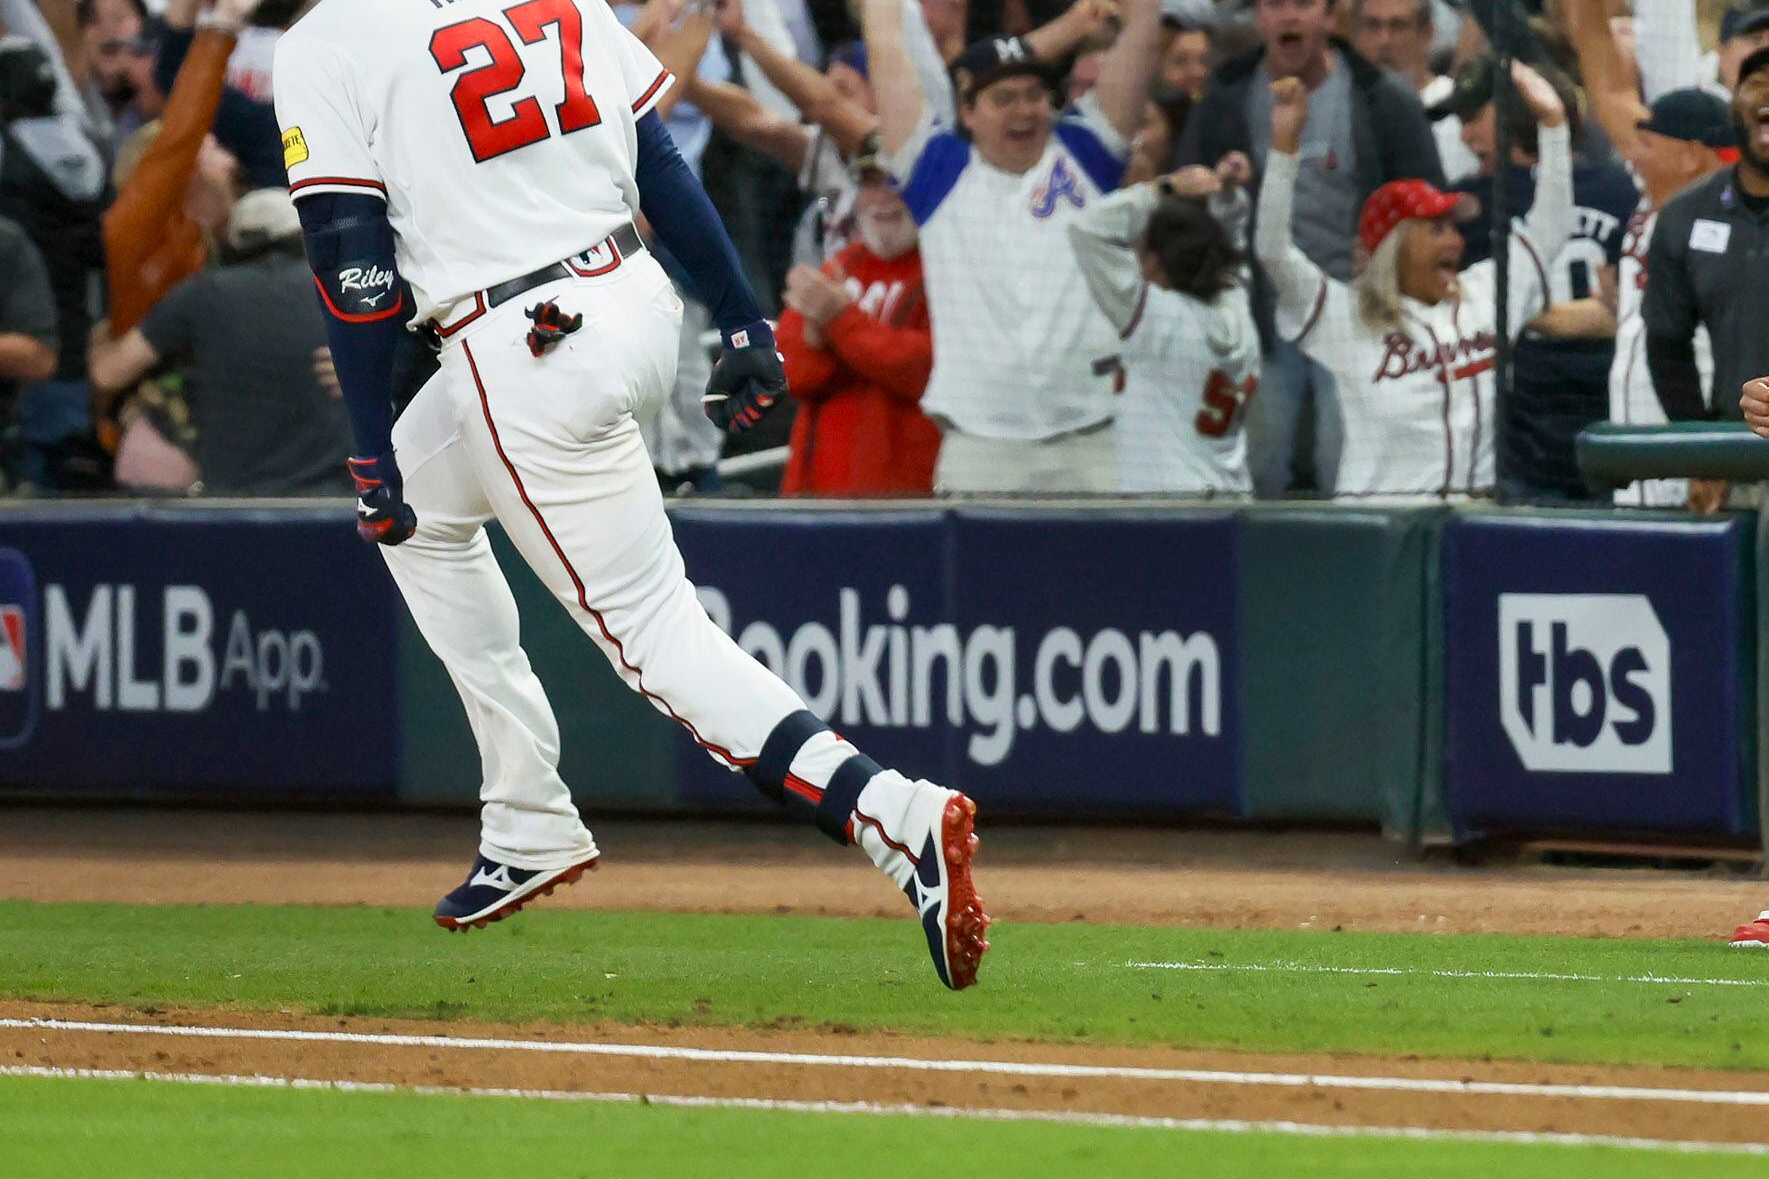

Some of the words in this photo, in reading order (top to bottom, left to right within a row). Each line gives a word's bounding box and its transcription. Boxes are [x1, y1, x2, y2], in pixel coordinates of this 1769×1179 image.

[338, 264, 394, 293] Riley
[45, 583, 216, 712] MLB
[220, 608, 324, 711] App
[1515, 619, 1656, 748] tbs
